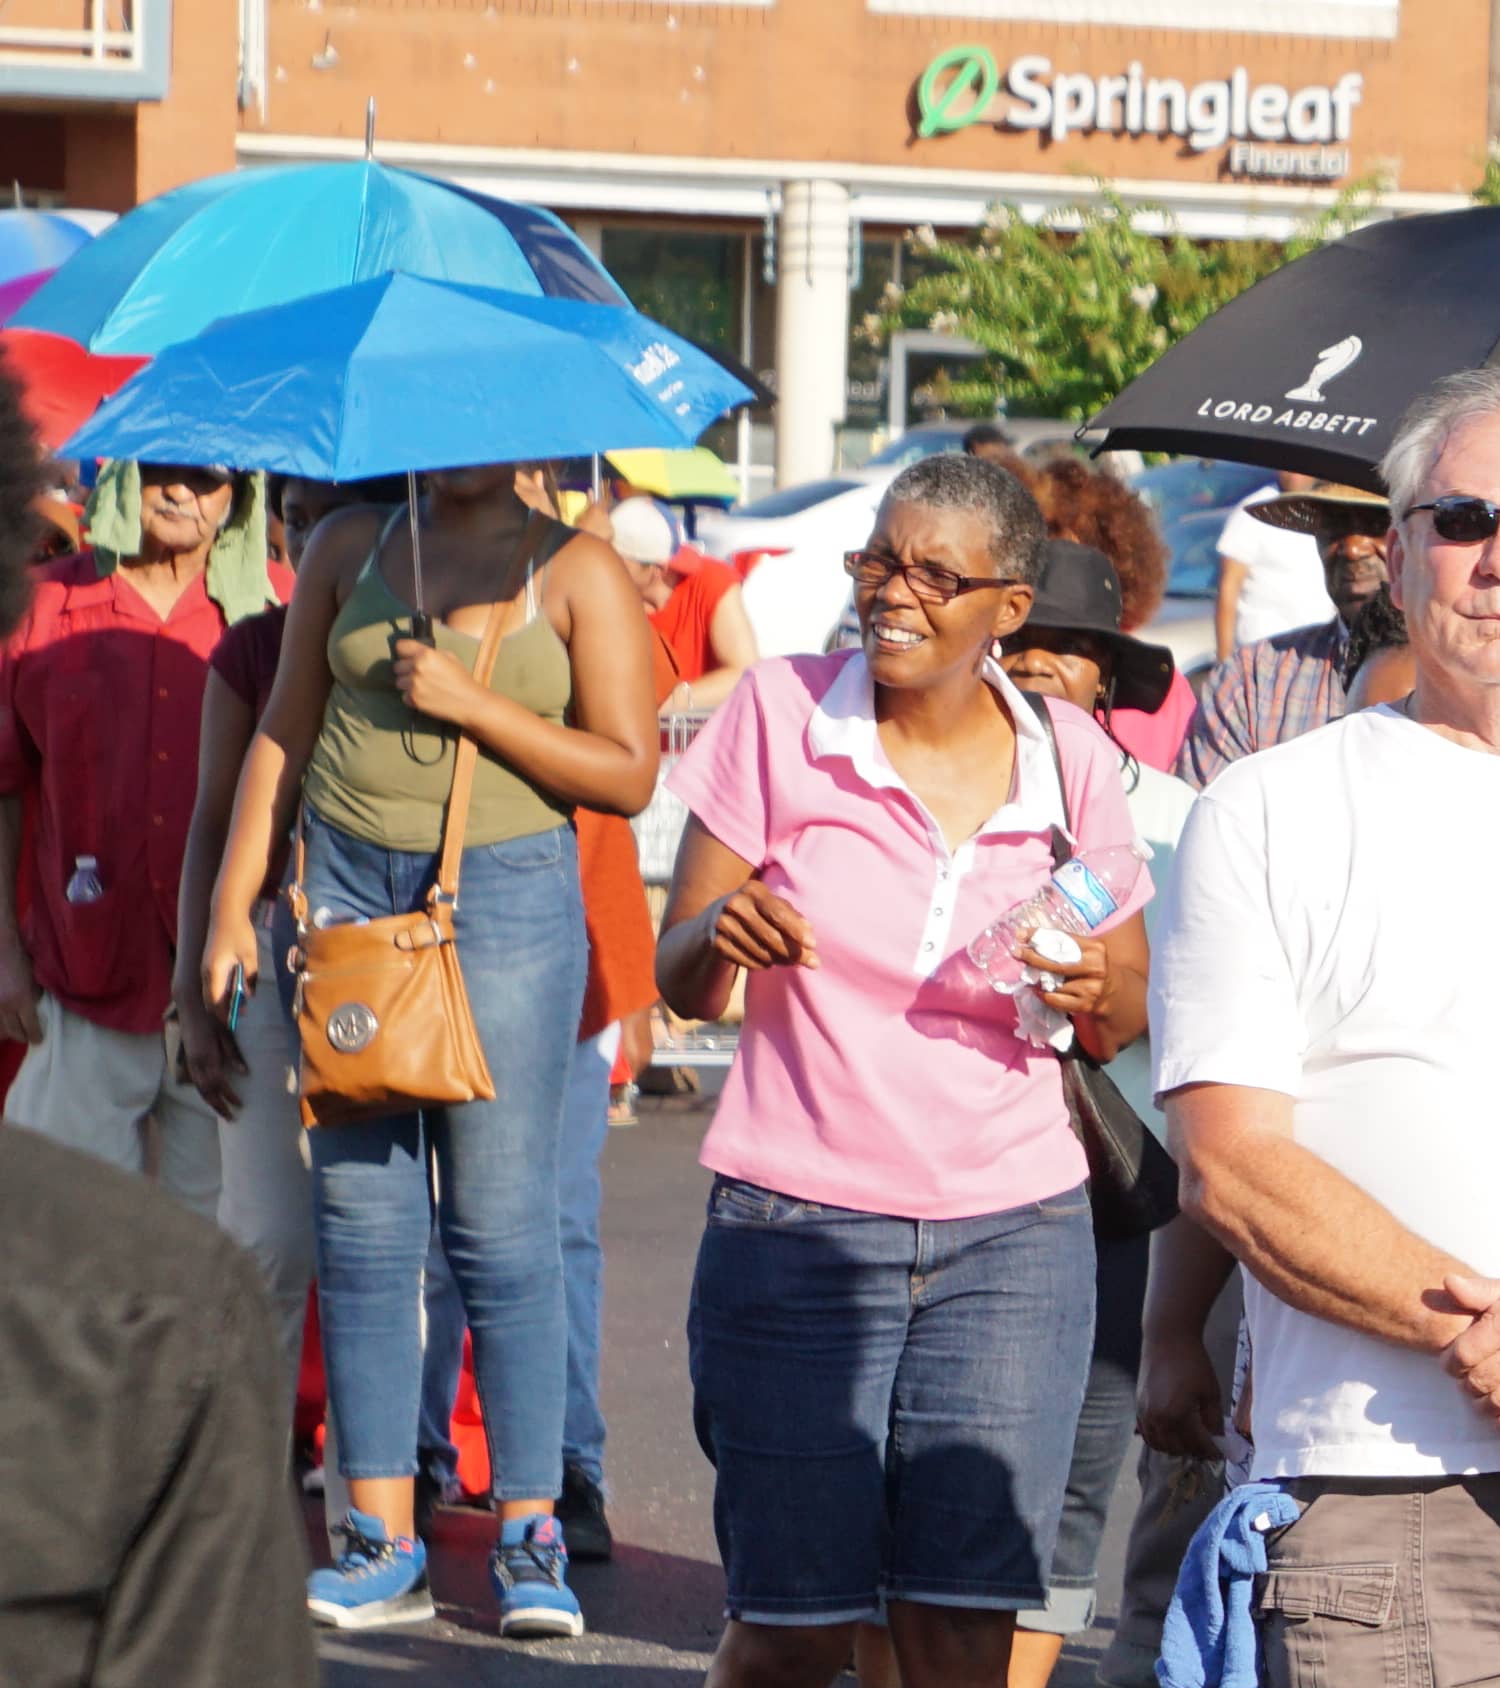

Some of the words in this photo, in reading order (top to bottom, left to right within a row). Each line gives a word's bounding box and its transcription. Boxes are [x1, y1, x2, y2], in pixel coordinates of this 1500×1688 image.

[1006, 55, 1362, 149] Springleaf
[1231, 144, 1348, 175] Financial
[1198, 398, 1273, 423] LORD
[1273, 408, 1378, 436] ABBETT
